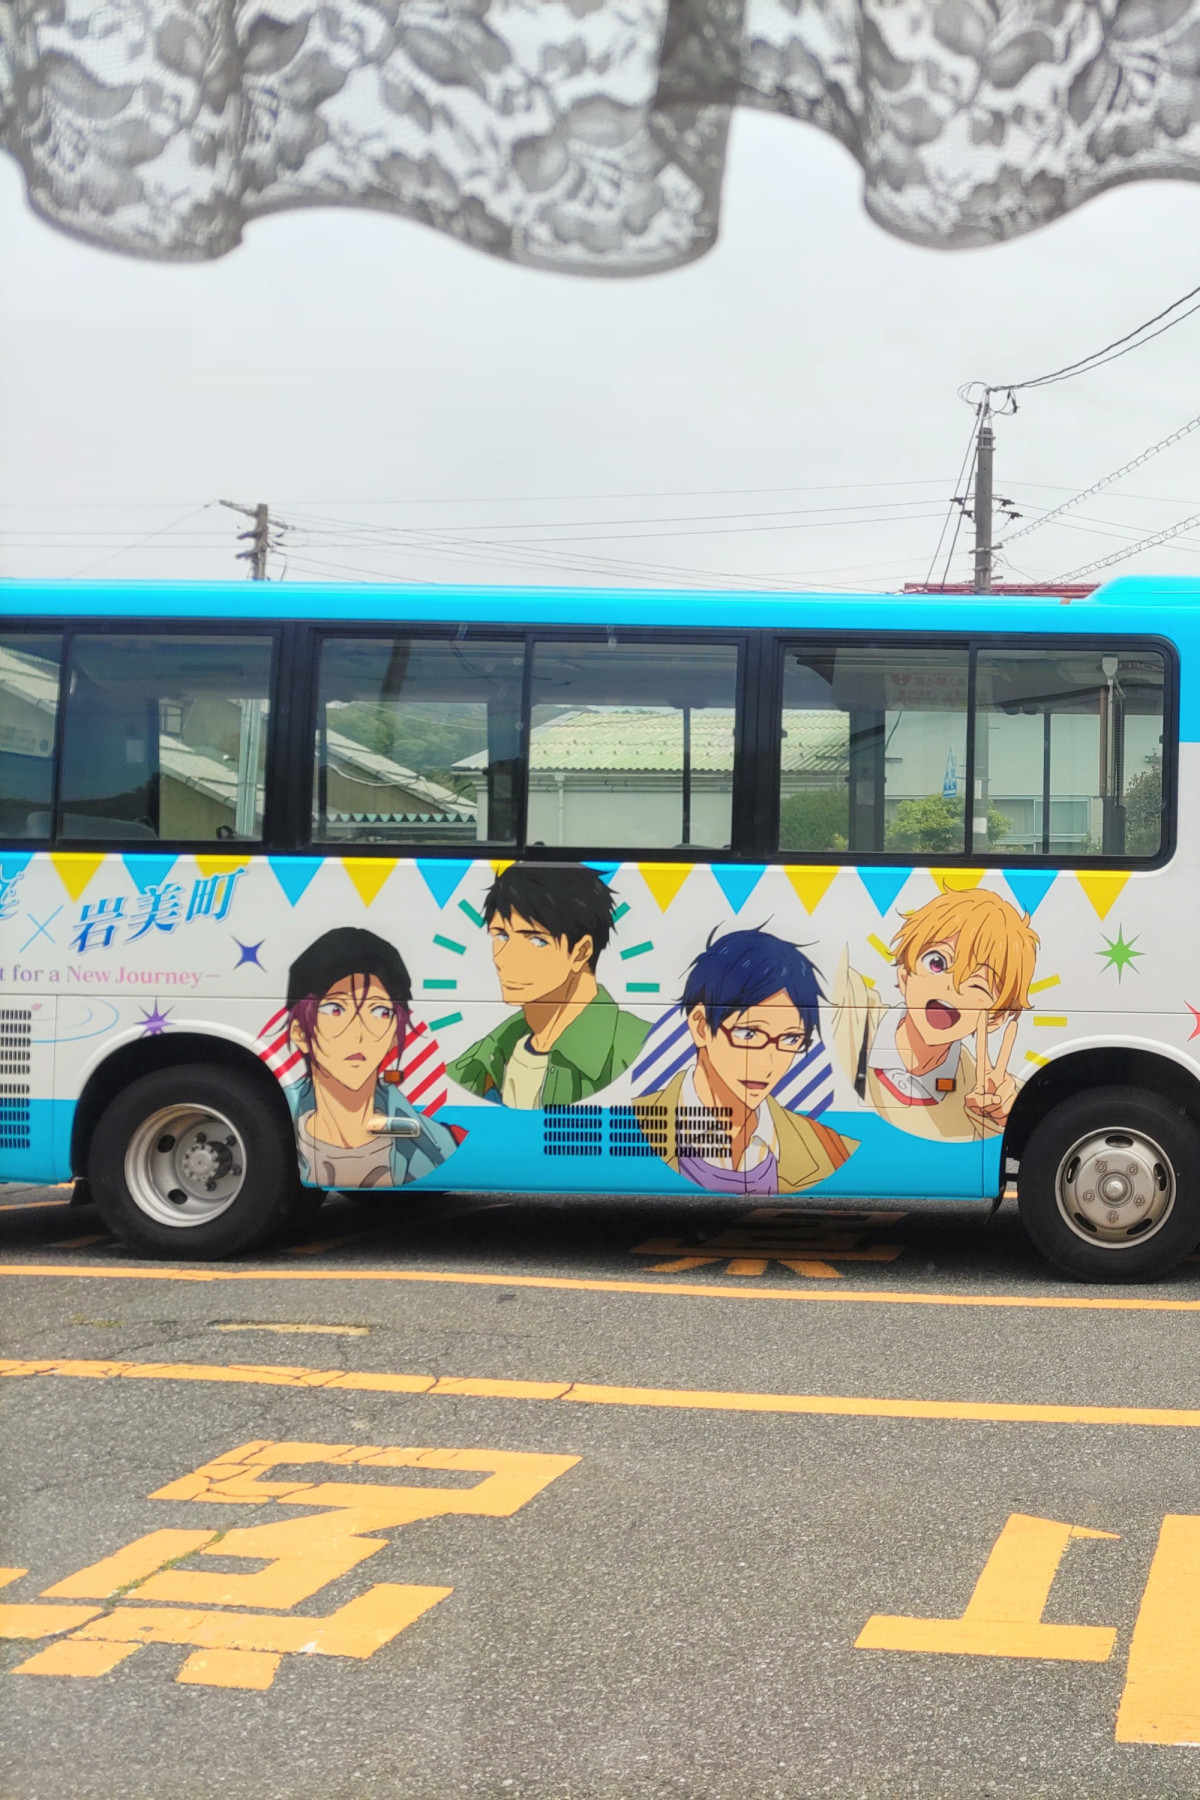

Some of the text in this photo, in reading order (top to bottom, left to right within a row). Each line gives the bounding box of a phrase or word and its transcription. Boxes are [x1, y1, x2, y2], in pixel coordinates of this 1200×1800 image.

[69, 867, 246, 954] 岩美町
[13, 964, 44, 982] for
[48, 969, 60, 983] a
[67, 965, 112, 984] New
